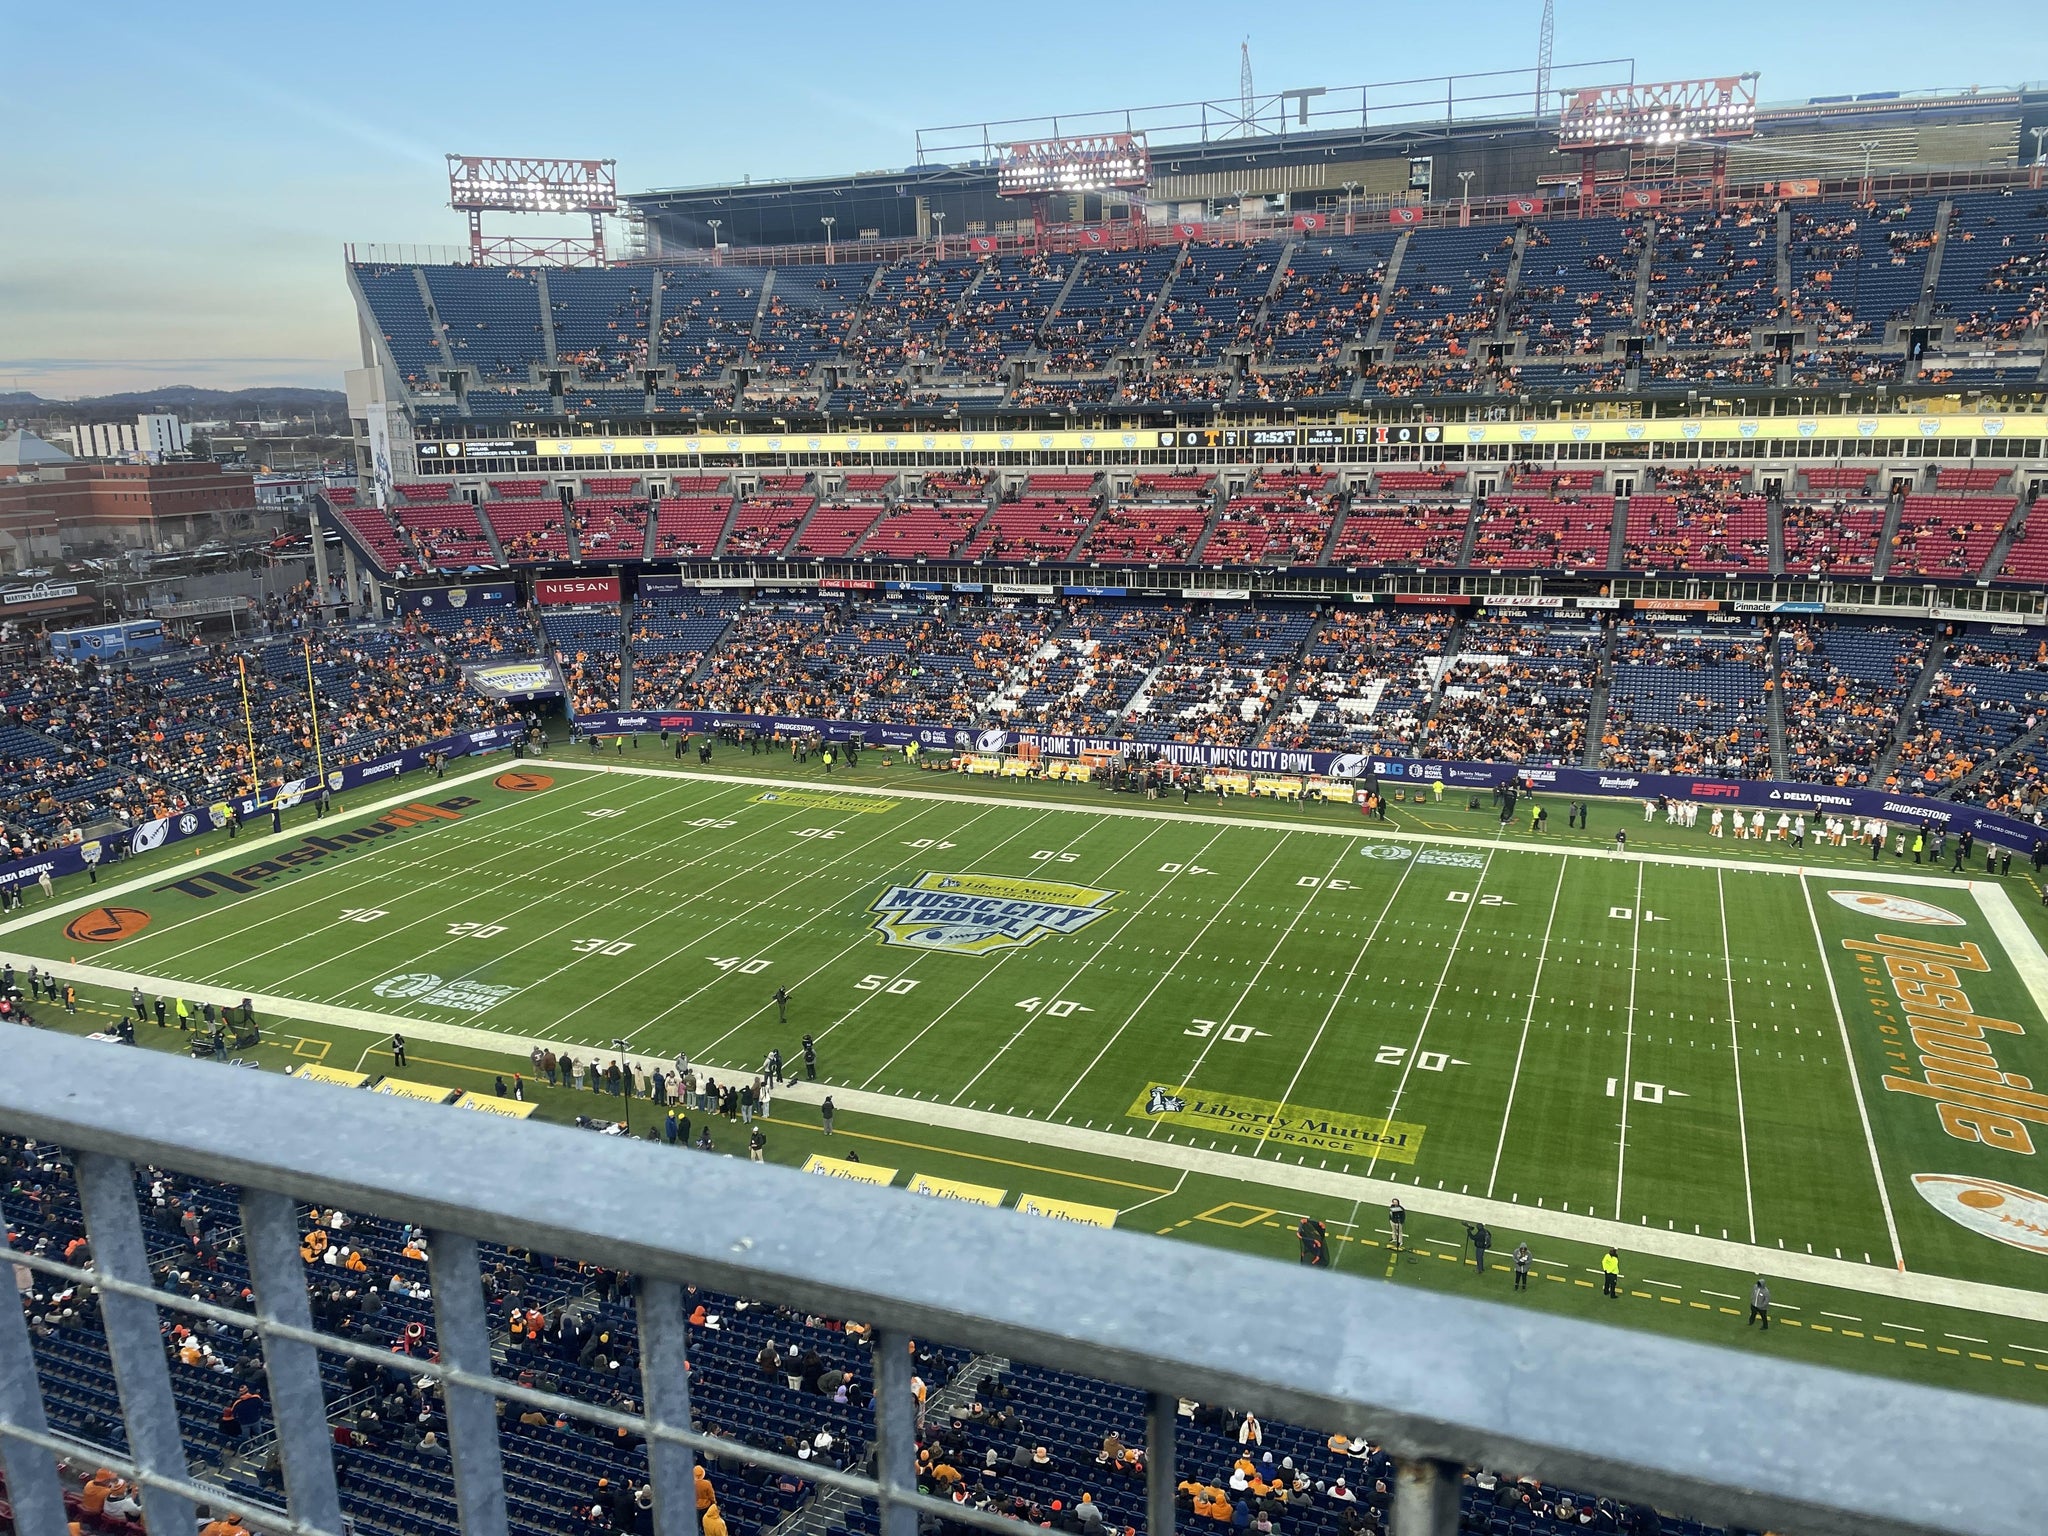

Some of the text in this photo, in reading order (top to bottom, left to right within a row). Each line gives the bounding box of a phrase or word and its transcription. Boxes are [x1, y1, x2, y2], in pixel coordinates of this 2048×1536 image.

[1254, 431, 1284, 443] 21:52
[5, 587, 76, 602] MARTIN'S BAR-B-QUE JOINT
[546, 582, 609, 593] NISSAN
[1735, 602, 1770, 611] Pinnacle
[660, 717, 693, 726] ESPN
[1073, 739, 1087, 755] TO
[1160, 745, 1207, 764] MUTUAL
[1210, 748, 1247, 767] MUSIC
[1251, 750, 1278, 770] CITY
[1280, 752, 1315, 772] BOWL
[362, 758, 402, 777] BRIDGESTONE
[1691, 783, 1740, 797] ESPN
[1783, 791, 1853, 806] DELTA DENTAL
[1882, 801, 1951, 822] BRIDGESTONE
[180, 814, 198, 834] SEC
[153, 796, 481, 898] Nashville
[1029, 850, 1081, 863] 50
[1416, 859, 1484, 869] SEASON
[1418, 855, 1485, 865] BOWL
[19, 863, 54, 878] DENTAL
[964, 882, 1078, 900] Liberty Mutual
[885, 889, 1095, 927] MUSIC CITY
[446, 922, 508, 938] 20
[911, 908, 1023, 934] BOWL
[571, 938, 637, 956] 30
[713, 957, 774, 974] 40
[853, 974, 920, 995] 50
[418, 996, 490, 1012] SEASON
[432, 988, 501, 1006] BOWL
[1014, 997, 1081, 1018] 40
[1855, 953, 1911, 1075] MUSIC CITY
[1183, 1019, 1256, 1043] 30
[1841, 933, 2048, 1155] Nashville
[1374, 1045, 1450, 1072] 20
[395, 1088, 436, 1103] Liberty
[1606, 1077, 1666, 1104] 10
[478, 1103, 523, 1118] Liberty
[1191, 1101, 1408, 1146] Liberty Mutual
[1229, 1124, 1355, 1150] INSURANCE
[830, 1168, 881, 1185] Liberty
[934, 1188, 990, 1206] Liberty
[1045, 1209, 1102, 1228] Liberty
